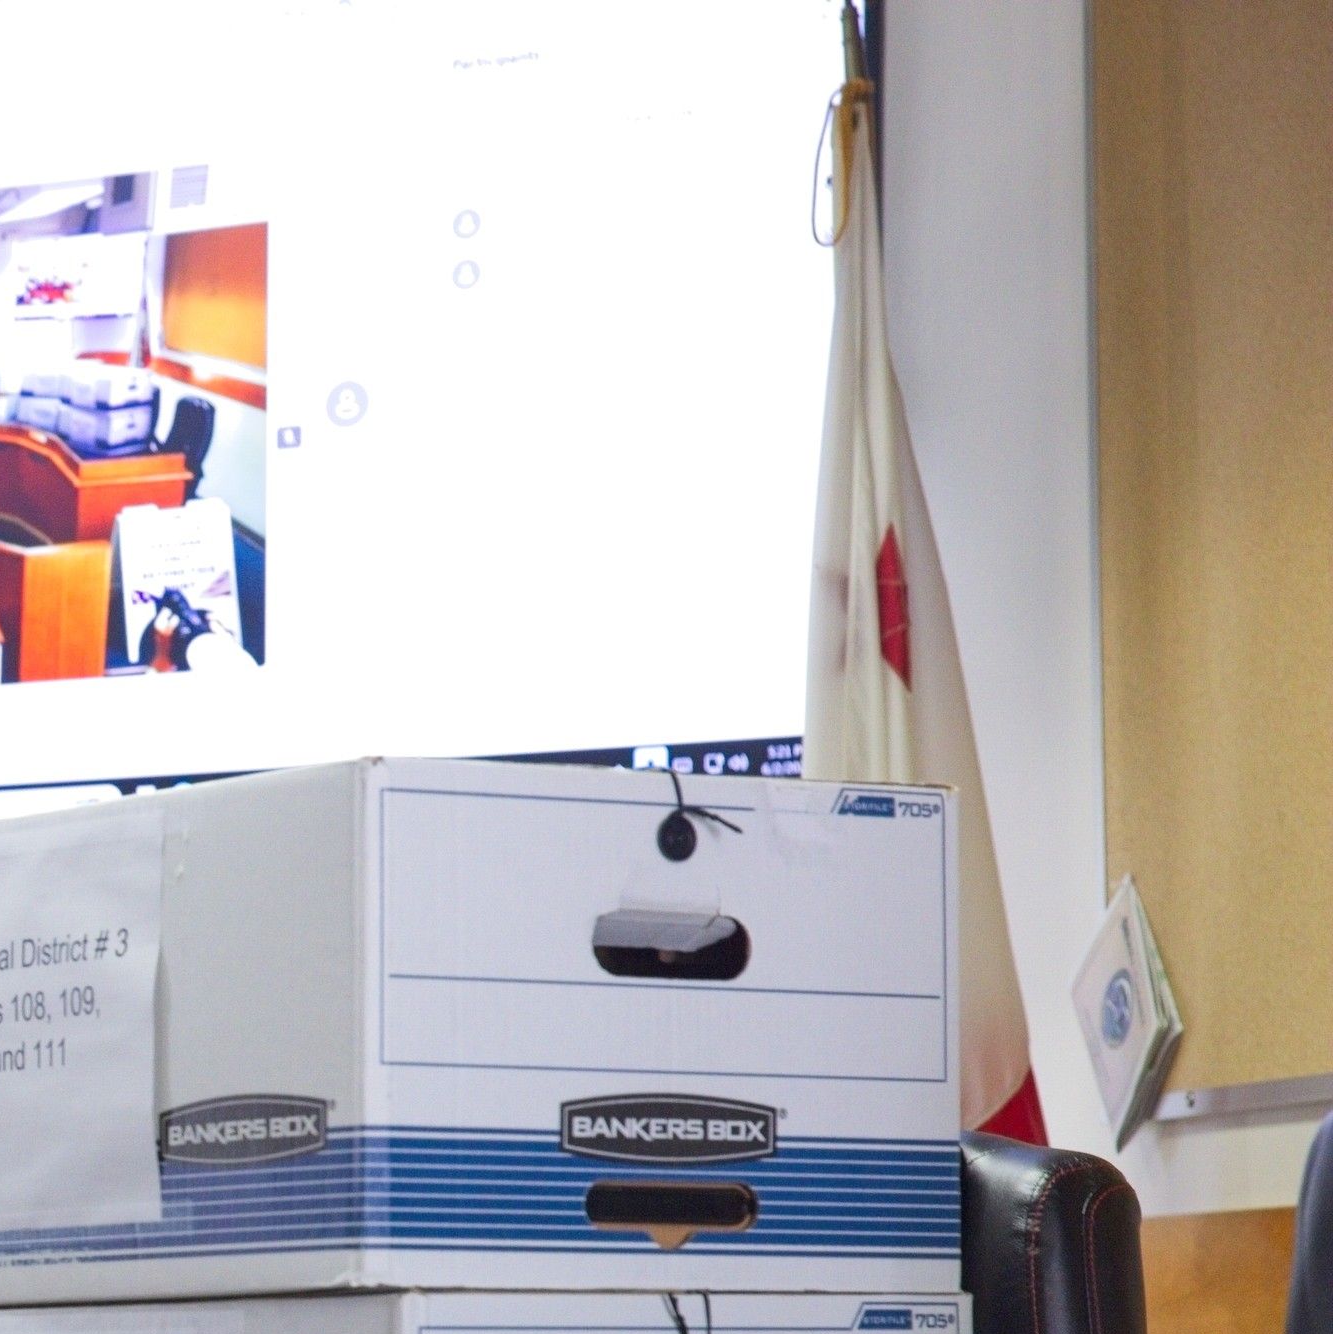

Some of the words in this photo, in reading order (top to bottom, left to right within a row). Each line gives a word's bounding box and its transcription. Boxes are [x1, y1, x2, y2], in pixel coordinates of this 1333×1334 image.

[20, 934, 89, 969] District
[94, 931, 109, 958] #
[114, 927, 129, 958] 3
[10, 990, 52, 1024] 108,
[59, 985, 101, 1018] 109,
[32, 1037, 66, 1069] 111
[168, 1119, 265, 1145] BANKERS
[269, 1114, 319, 1139] BOX
[572, 1115, 704, 1141] BANKERS
[708, 1118, 766, 1143] BOX
